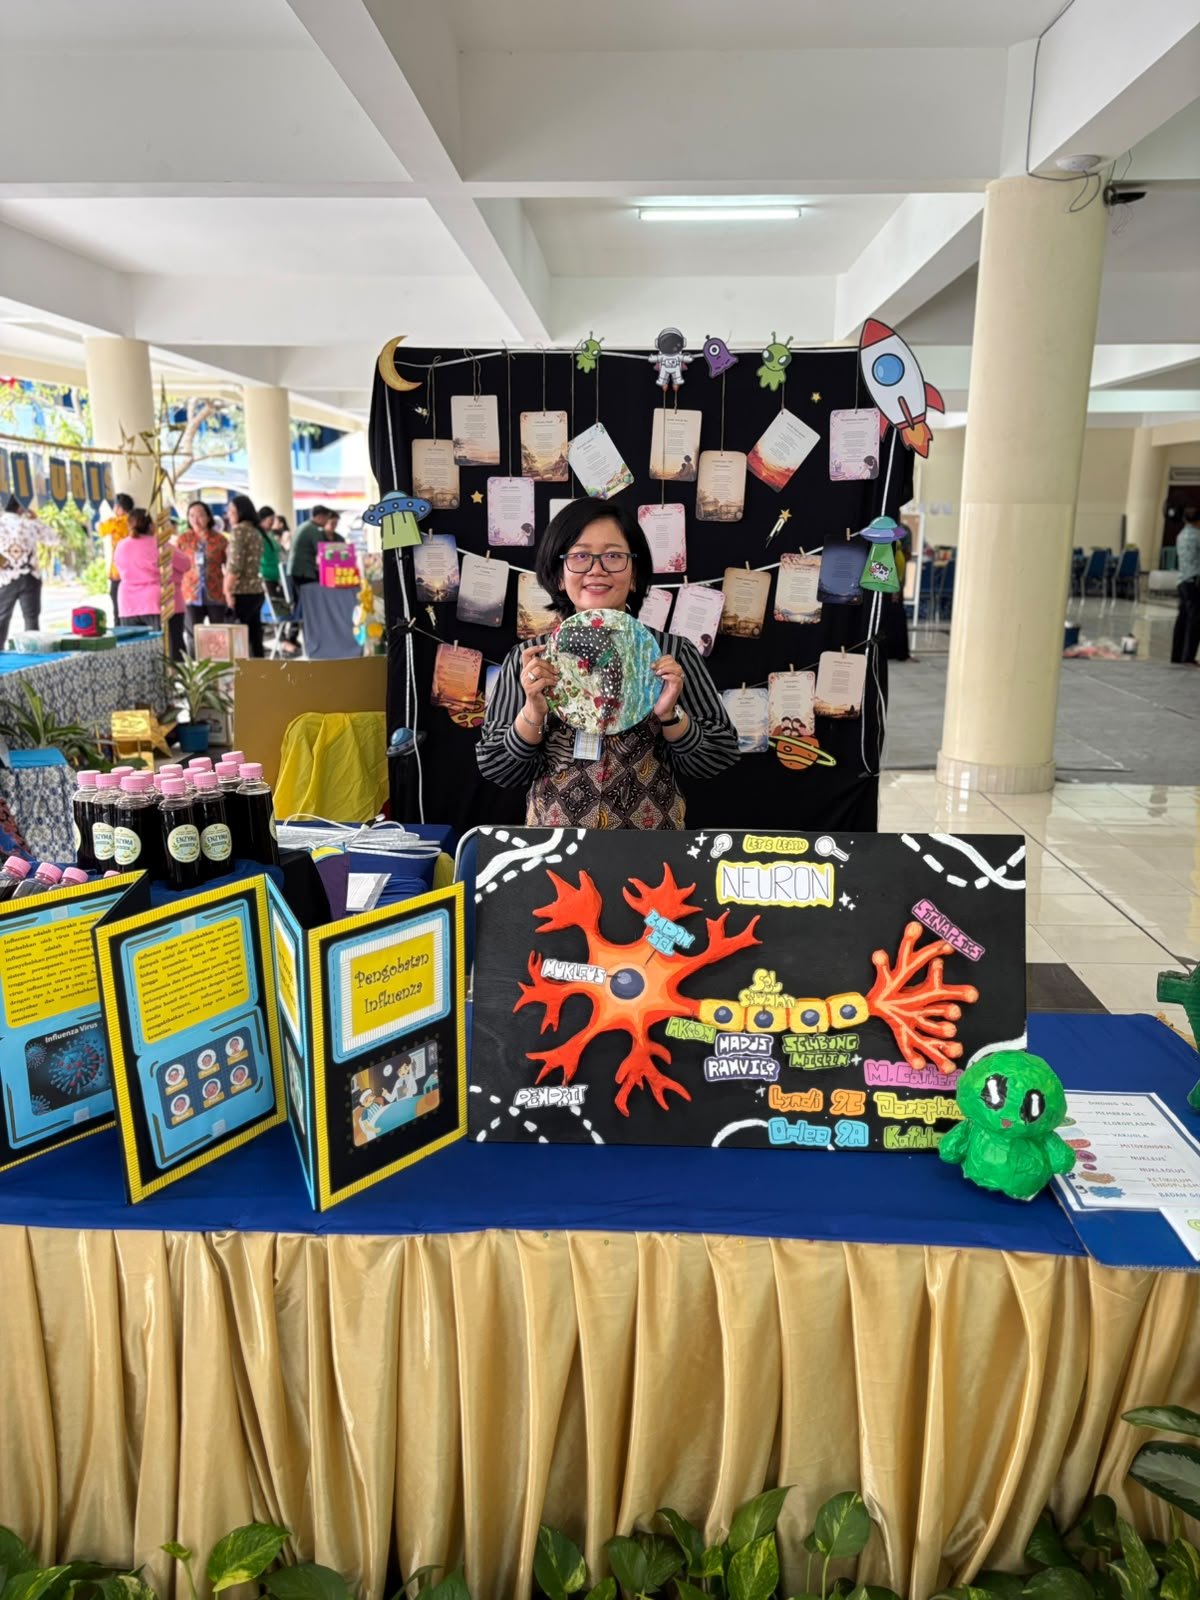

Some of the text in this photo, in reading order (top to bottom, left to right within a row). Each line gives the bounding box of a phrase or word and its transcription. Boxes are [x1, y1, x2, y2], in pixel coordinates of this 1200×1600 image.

[776, 838, 807, 852] LEARN
[723, 865, 830, 901] NEURON
[644, 908, 695, 949] BADAN
[913, 900, 984, 960] SINAPSIS
[354, 953, 429, 989] Pengobatan
[542, 958, 608, 985] NUKLEUS
[365, 982, 423, 1014] Influenza
[45, 1022, 98, 1043] Influenza Virus
[867, 1063, 894, 1083] M.
[513, 1085, 588, 1108] DENDRIT
[772, 1087, 821, 1109] Lyndi
[837, 1120, 867, 1145] 9A
